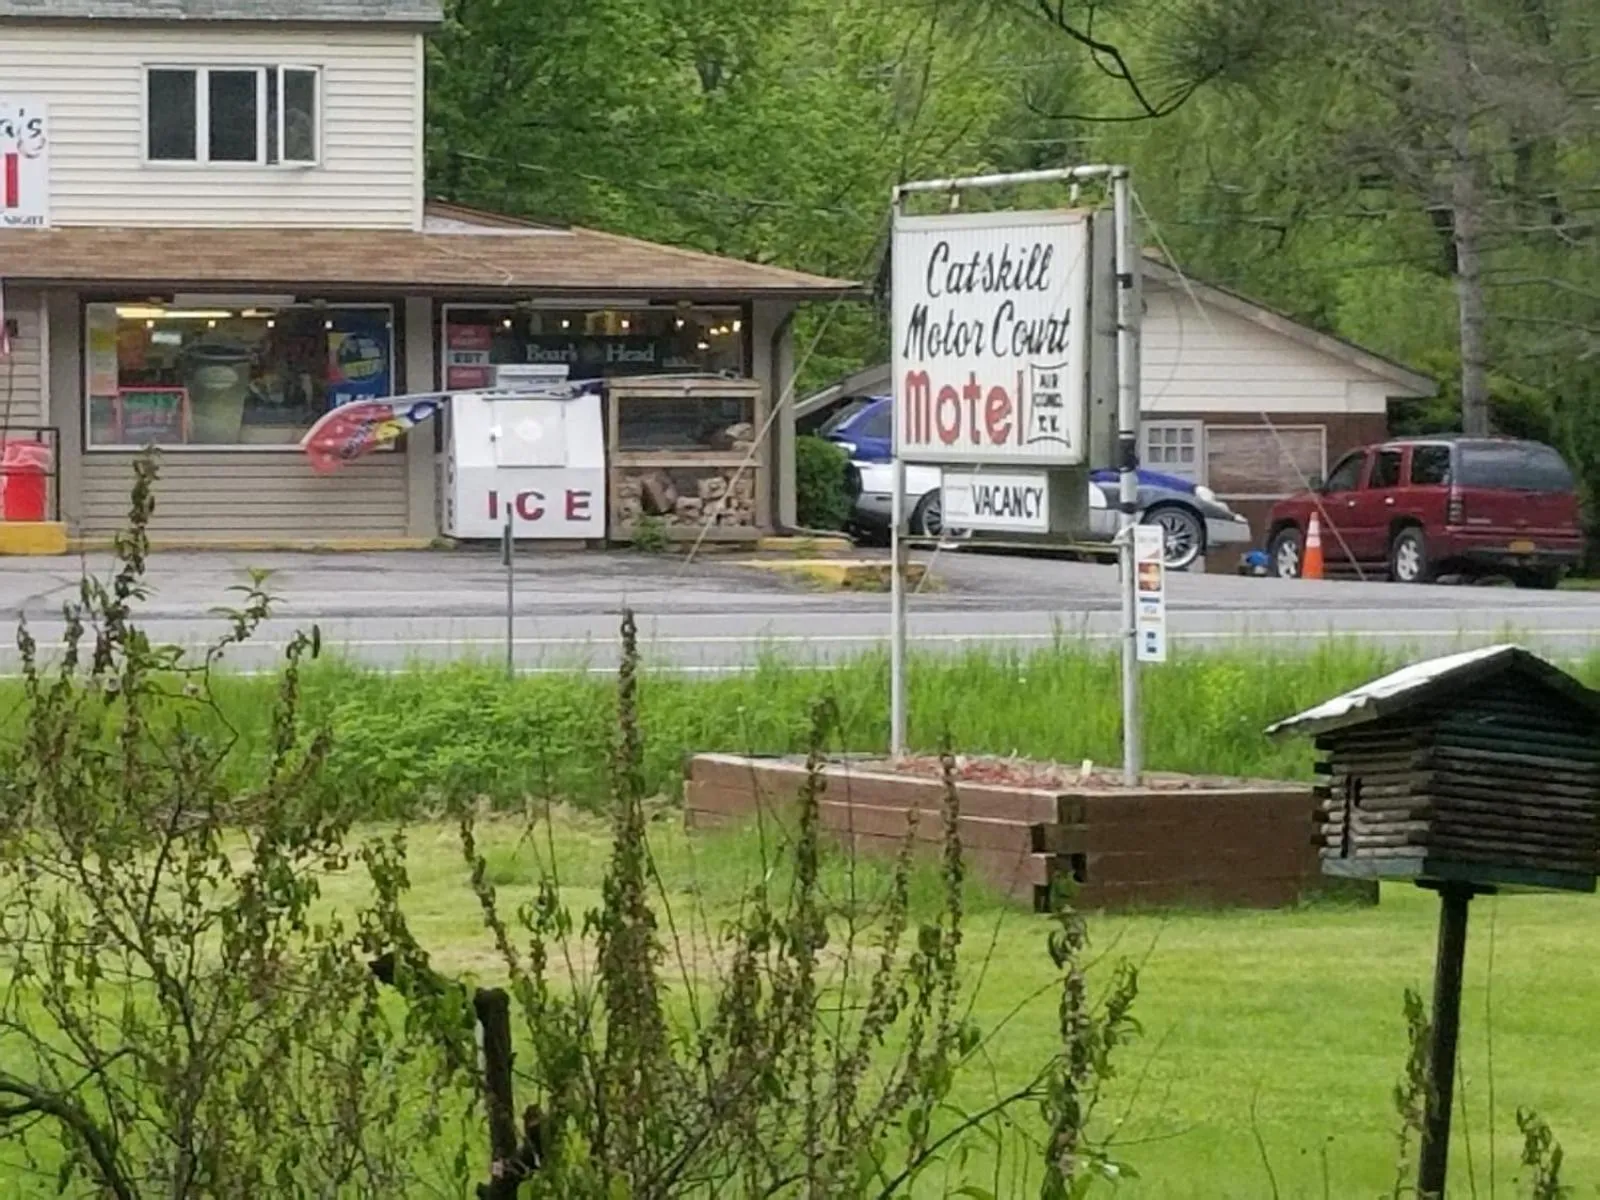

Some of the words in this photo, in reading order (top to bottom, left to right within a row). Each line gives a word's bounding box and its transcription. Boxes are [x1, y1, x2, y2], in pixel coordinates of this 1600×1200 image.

[926, 240, 1053, 298] Catskill
[902, 302, 984, 361] Motor
[991, 299, 1071, 357] Court
[606, 342, 656, 362] Head
[1039, 373, 1059, 389] AIR
[905, 369, 1024, 446] Motel
[488, 490, 592, 521] ICE
[971, 484, 1043, 518] VACANCY
